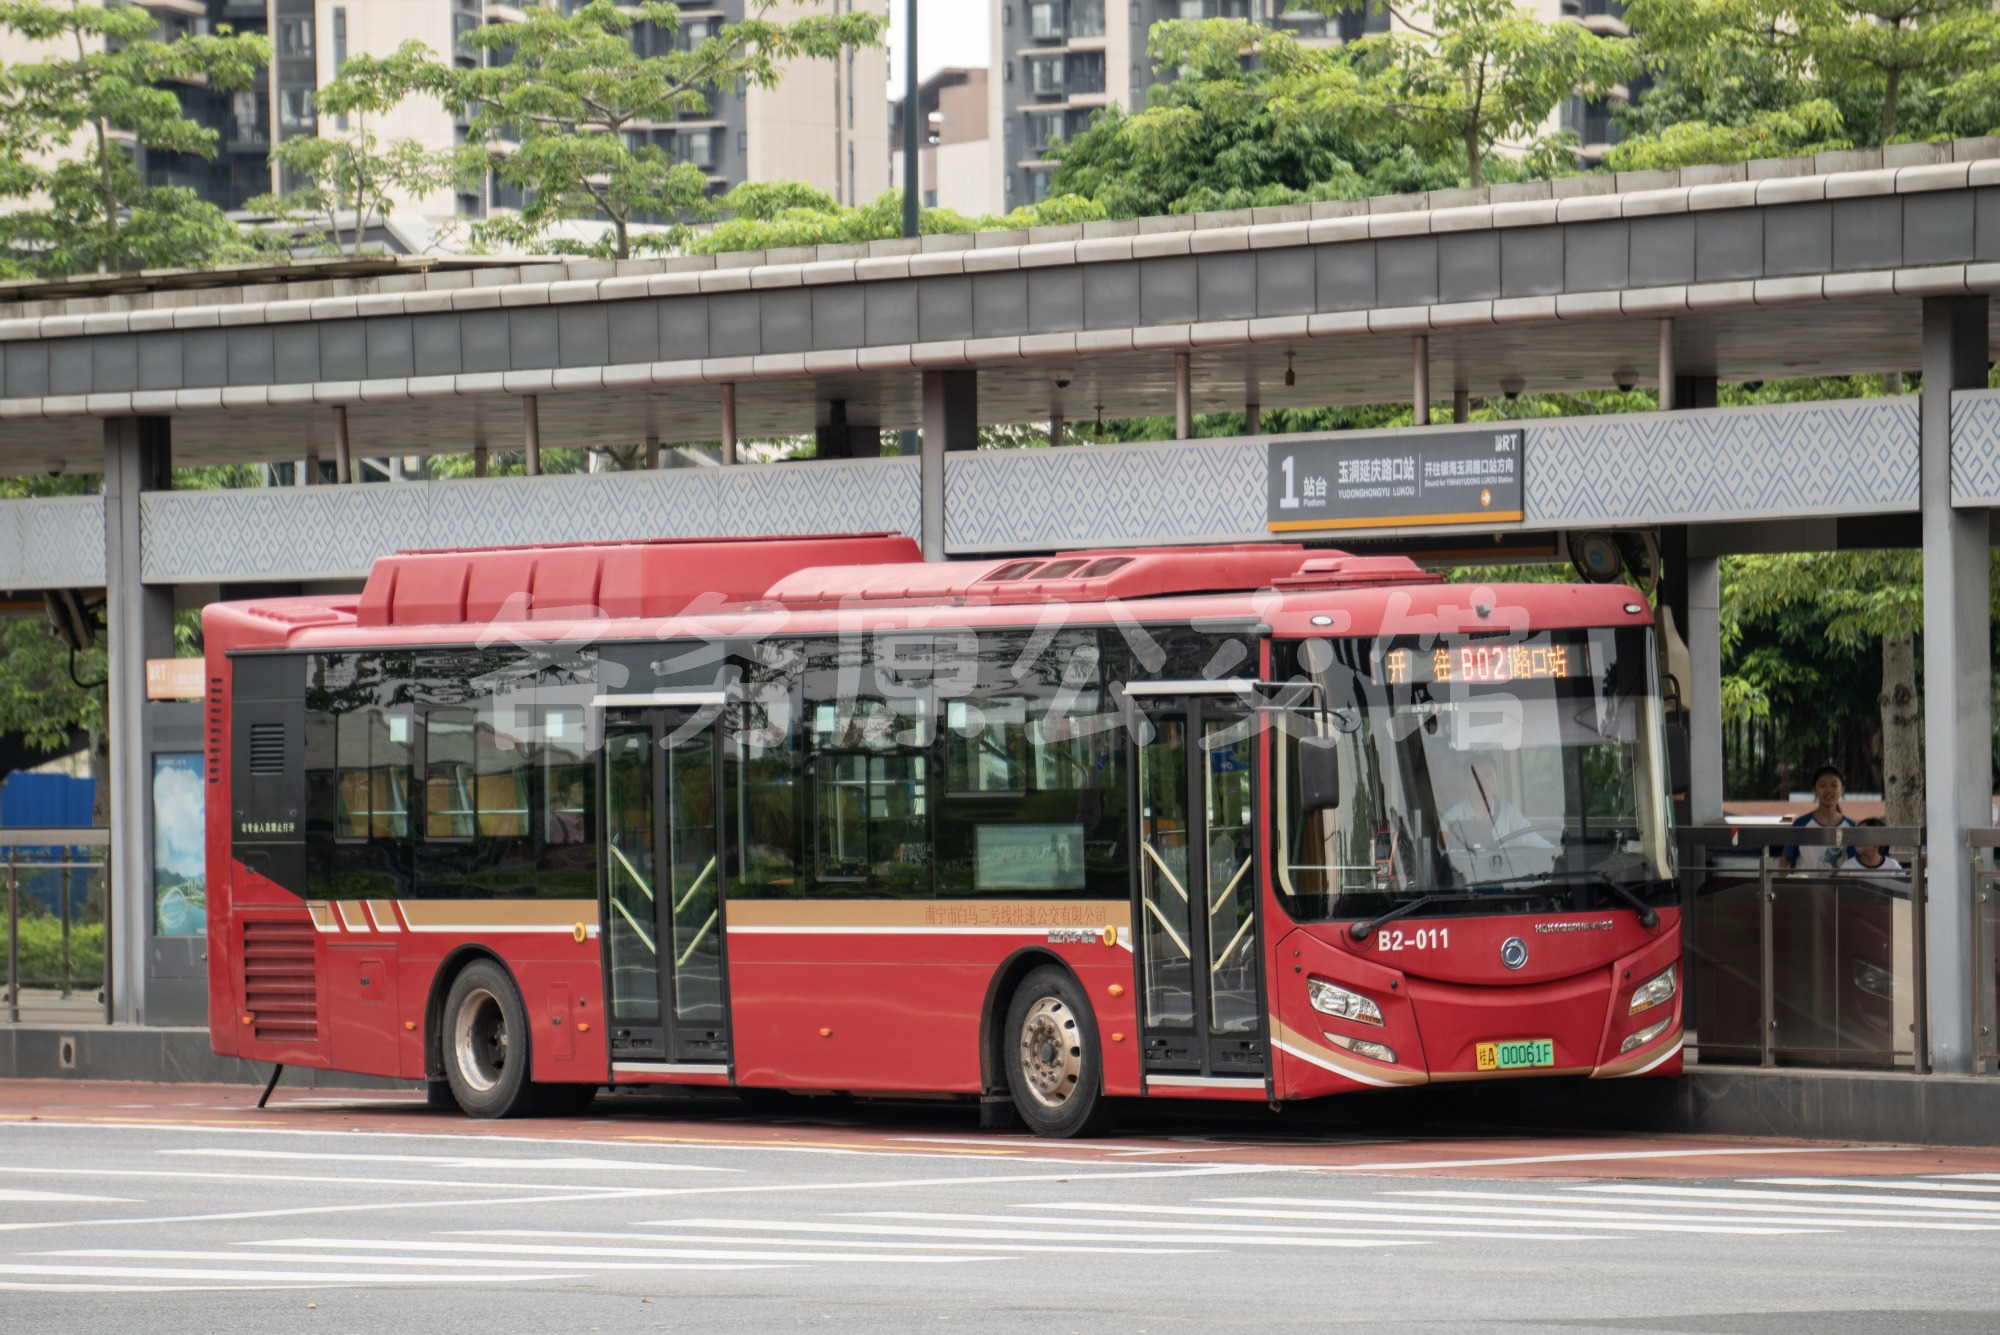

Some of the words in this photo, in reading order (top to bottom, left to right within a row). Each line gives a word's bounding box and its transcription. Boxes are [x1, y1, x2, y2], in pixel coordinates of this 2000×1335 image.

[1338, 457, 1415, 483] 玉洞延庆路口站
[1424, 457, 1514, 477] 开往银海玉洞路口站方向
[1279, 455, 1299, 509] 1
[1303, 476, 1327, 497] 站台
[1498, 475, 1514, 484] Station
[1393, 486, 1415, 496] LUKOU
[1303, 498, 1326, 507] Platform
[924, 904, 1106, 926] 南宁市白马二号线快速公交有限公司
[1378, 928, 1449, 952] B2-011
